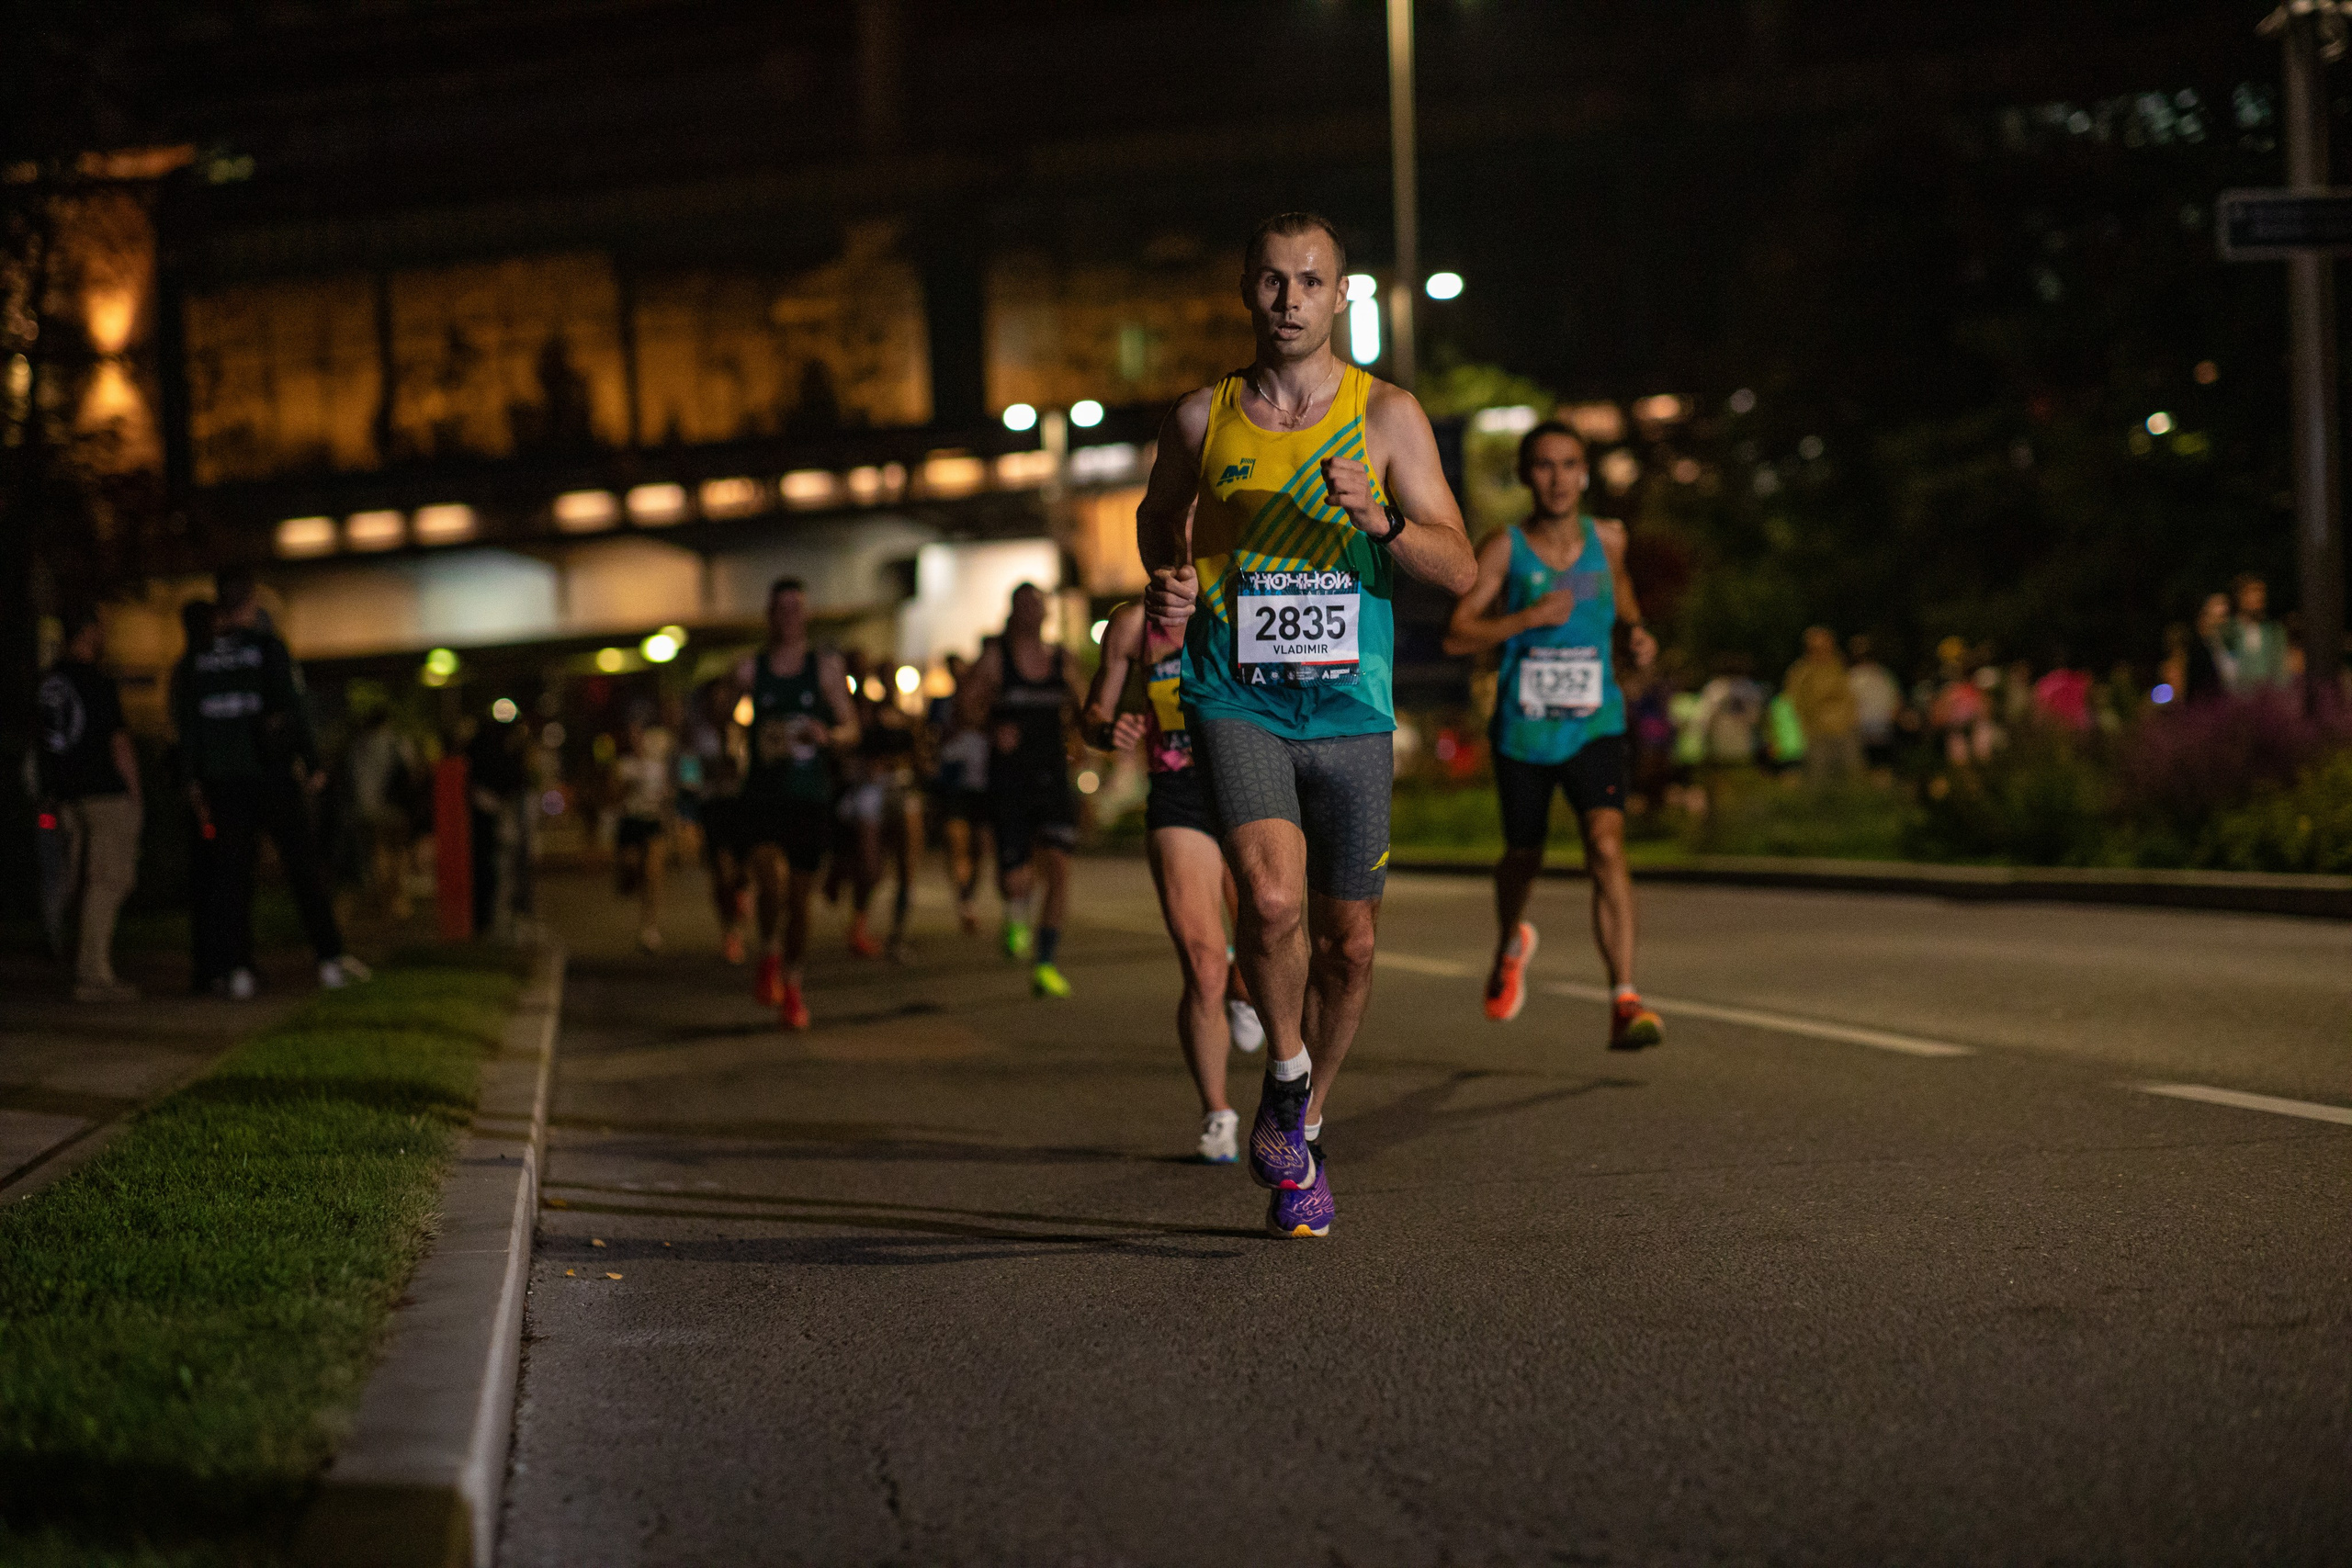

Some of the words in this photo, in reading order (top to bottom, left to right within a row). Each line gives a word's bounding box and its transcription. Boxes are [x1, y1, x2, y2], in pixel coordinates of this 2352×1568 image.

[1255, 604, 1346, 641] 2835
[1273, 644, 1329, 655] VLADIMIR
[1250, 667, 1267, 684] A
